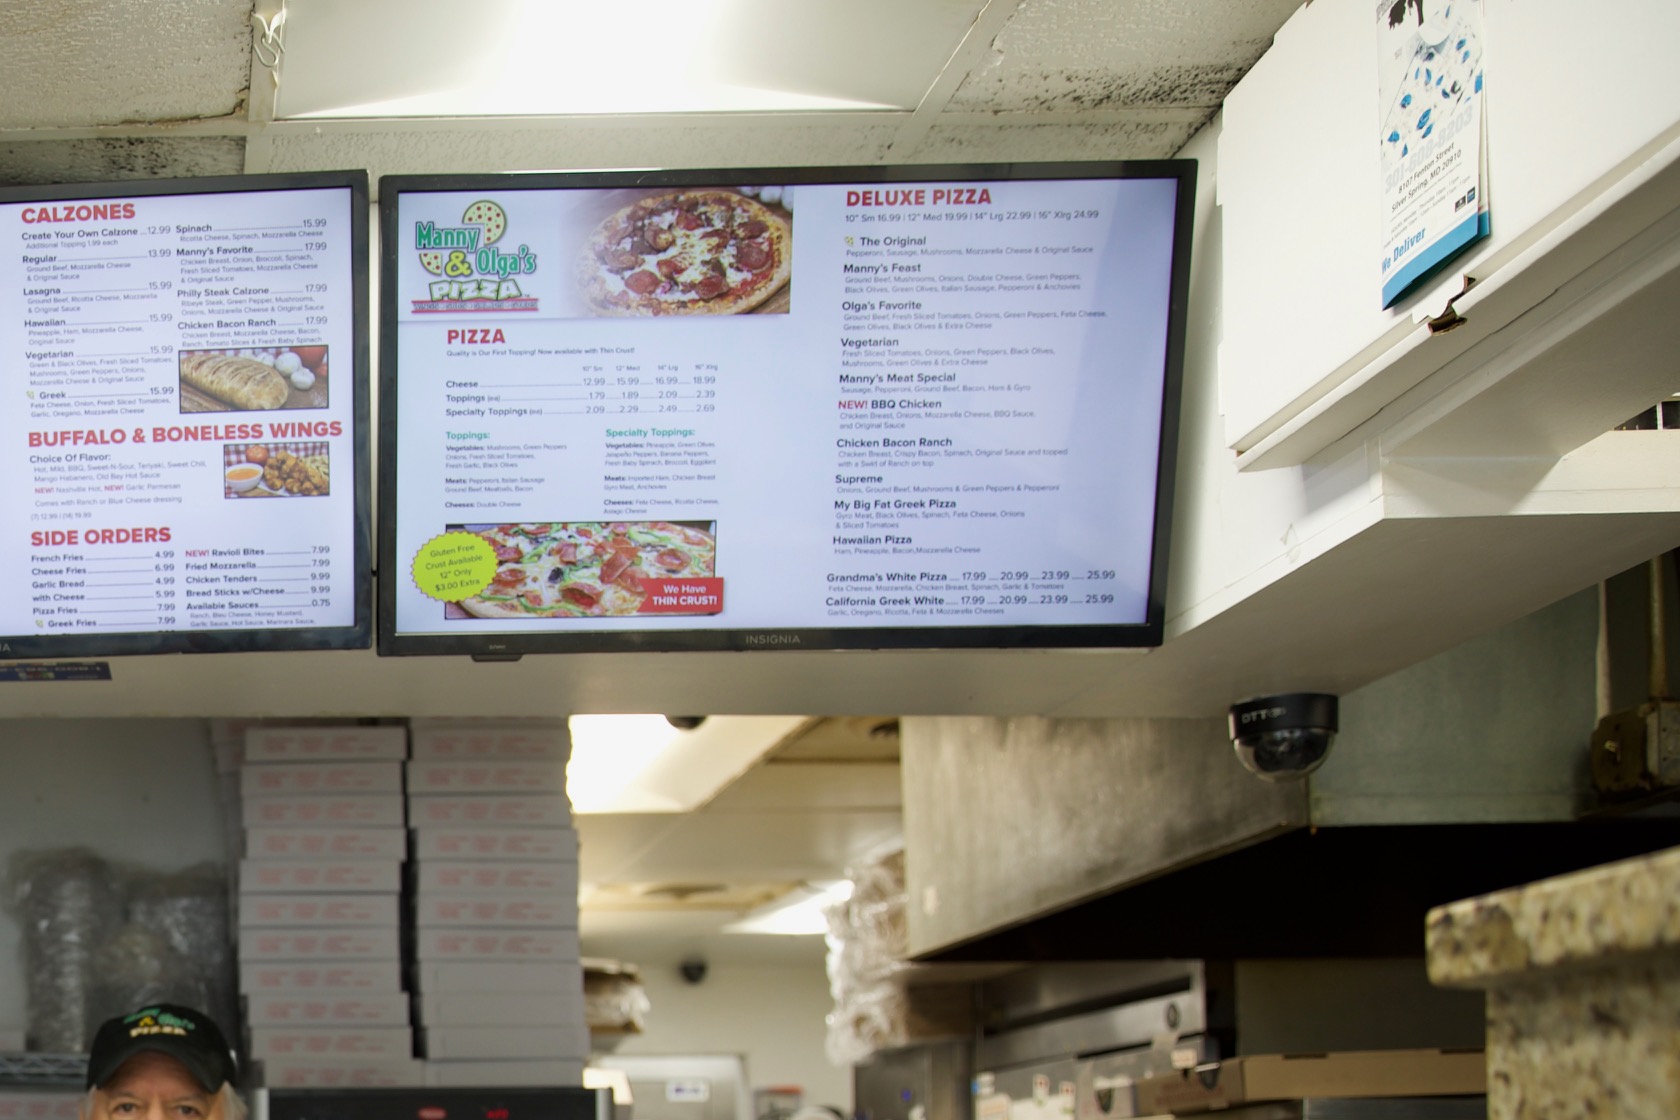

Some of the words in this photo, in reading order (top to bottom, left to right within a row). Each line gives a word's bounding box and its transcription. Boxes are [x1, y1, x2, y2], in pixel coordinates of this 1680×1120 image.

[1399, 176, 1412, 194] 8107
[1413, 162, 1435, 182] Fenton
[1432, 142, 1455, 163] Street
[846, 190, 926, 207] DELUXE
[932, 188, 992, 206] PIZZA
[1392, 197, 1407, 213] Silver
[1430, 166, 1441, 181] MD
[21, 203, 136, 224] CALZONES
[415, 221, 479, 253] Manny
[860, 237, 881, 247] The
[883, 236, 927, 249] Original
[1381, 257, 1391, 274] We
[1393, 228, 1426, 263] Deliver
[444, 250, 472, 278] &
[476, 245, 537, 278] Olga's
[429, 278, 523, 301] PIZZA
[447, 328, 506, 345] PIZZA
[28, 428, 127, 448] BUFFALO
[132, 427, 145, 443] &
[152, 423, 264, 443] BONELESS
[269, 421, 343, 439] WINGS
[836, 438, 881, 448] Chicken
[882, 437, 916, 448] Bacon
[919, 437, 953, 447] Ranch
[30, 530, 79, 547] SIDE
[84, 526, 172, 545] ORDERS
[430, 546, 455, 559] Gluten
[456, 544, 475, 555] Free
[425, 560, 449, 571] Crust
[449, 554, 483, 568] Available
[439, 570, 456, 580] 12"
[456, 568, 473, 580] Only
[435, 581, 459, 593] $3.00
[459, 578, 481, 589] Extra
[663, 584, 680, 594] We
[681, 584, 707, 594] Have
[652, 596, 679, 607] THIN
[680, 595, 718, 606] CRUST!
[746, 633, 801, 644] INSIGNIA
